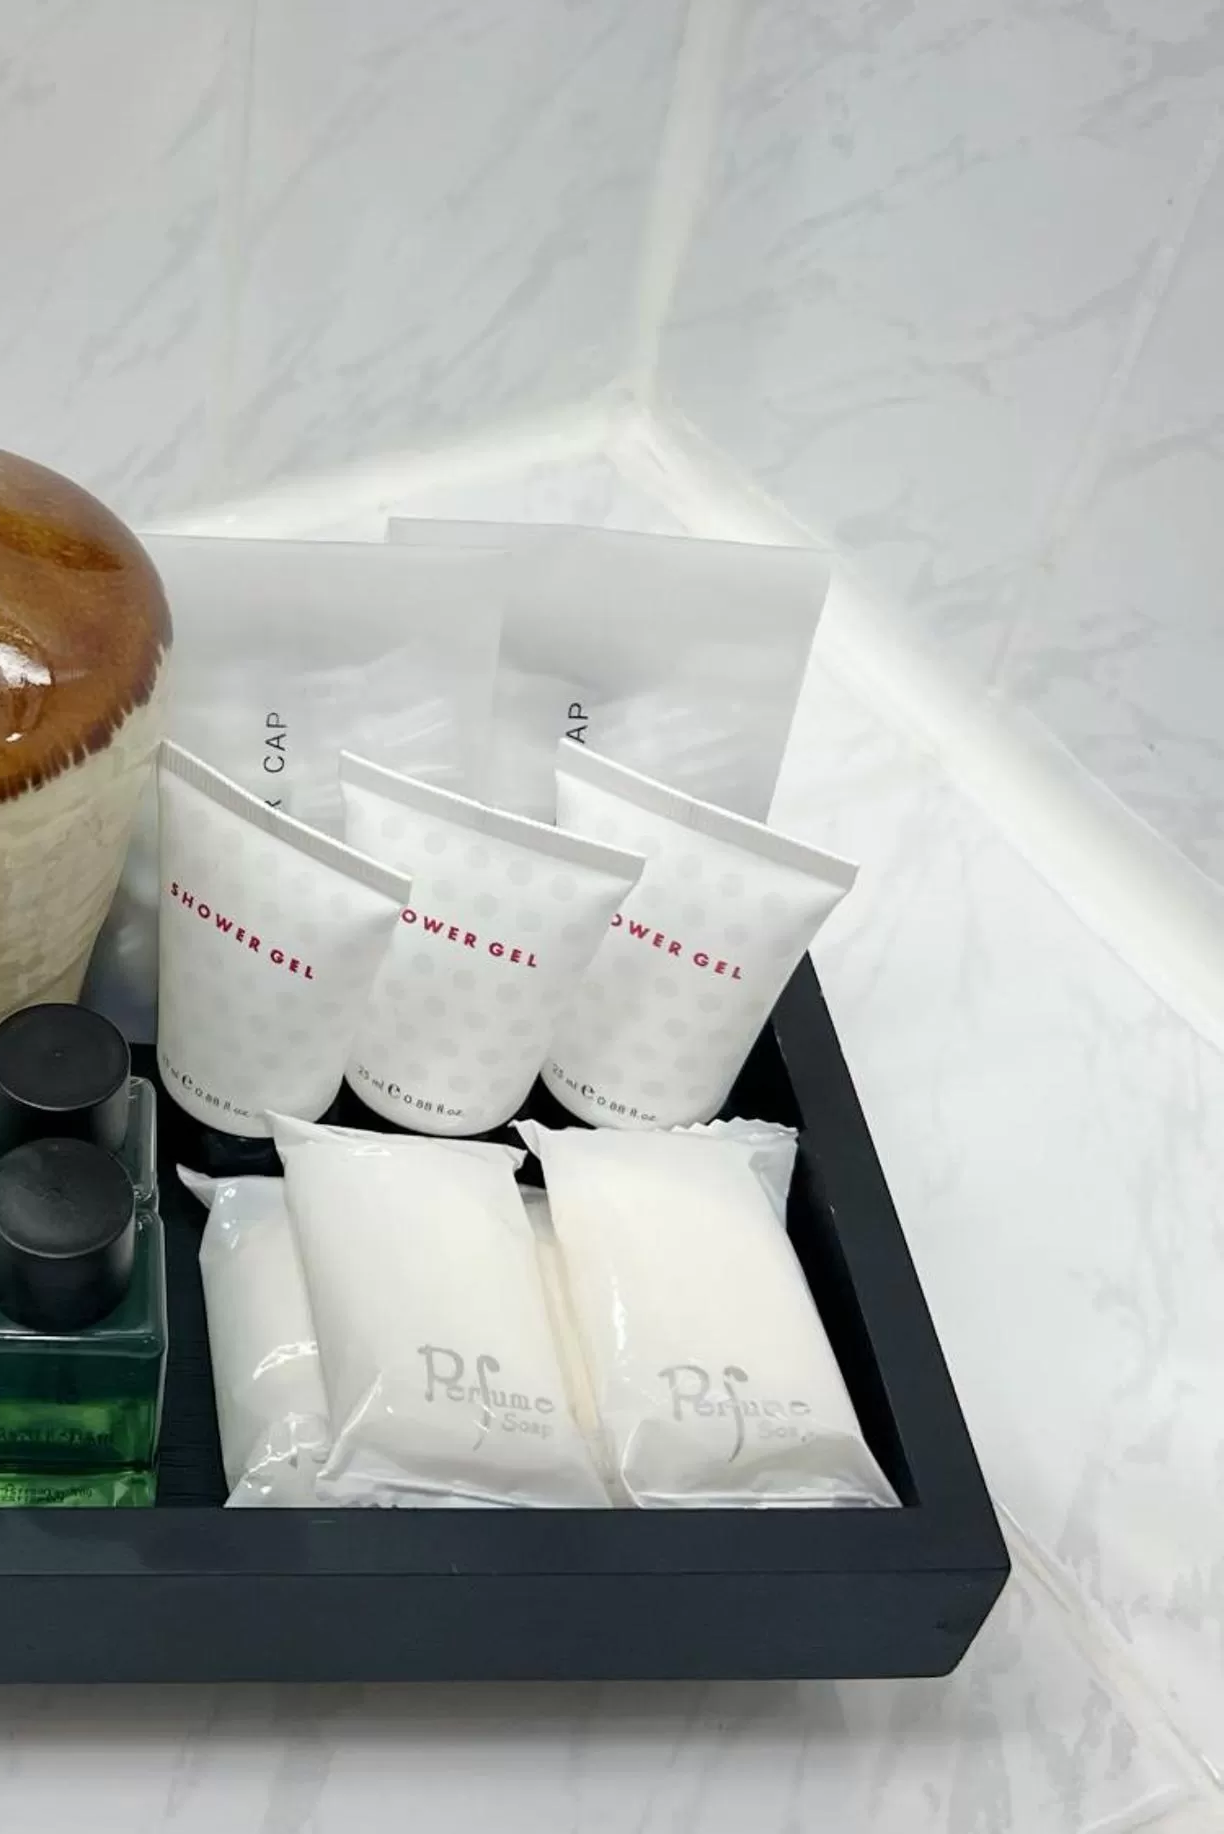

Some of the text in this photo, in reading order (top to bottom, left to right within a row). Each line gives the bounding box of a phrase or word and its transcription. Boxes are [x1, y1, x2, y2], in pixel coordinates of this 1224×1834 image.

[263, 712, 287, 773] CAP
[565, 702, 588, 744] AP
[171, 882, 313, 979] SHOWER GEL
[402, 909, 537, 968] OWER GEL
[611, 913, 742, 980] OWER GEL
[417, 1344, 555, 1451] Perfume
[501, 1413, 553, 1439] Soap
